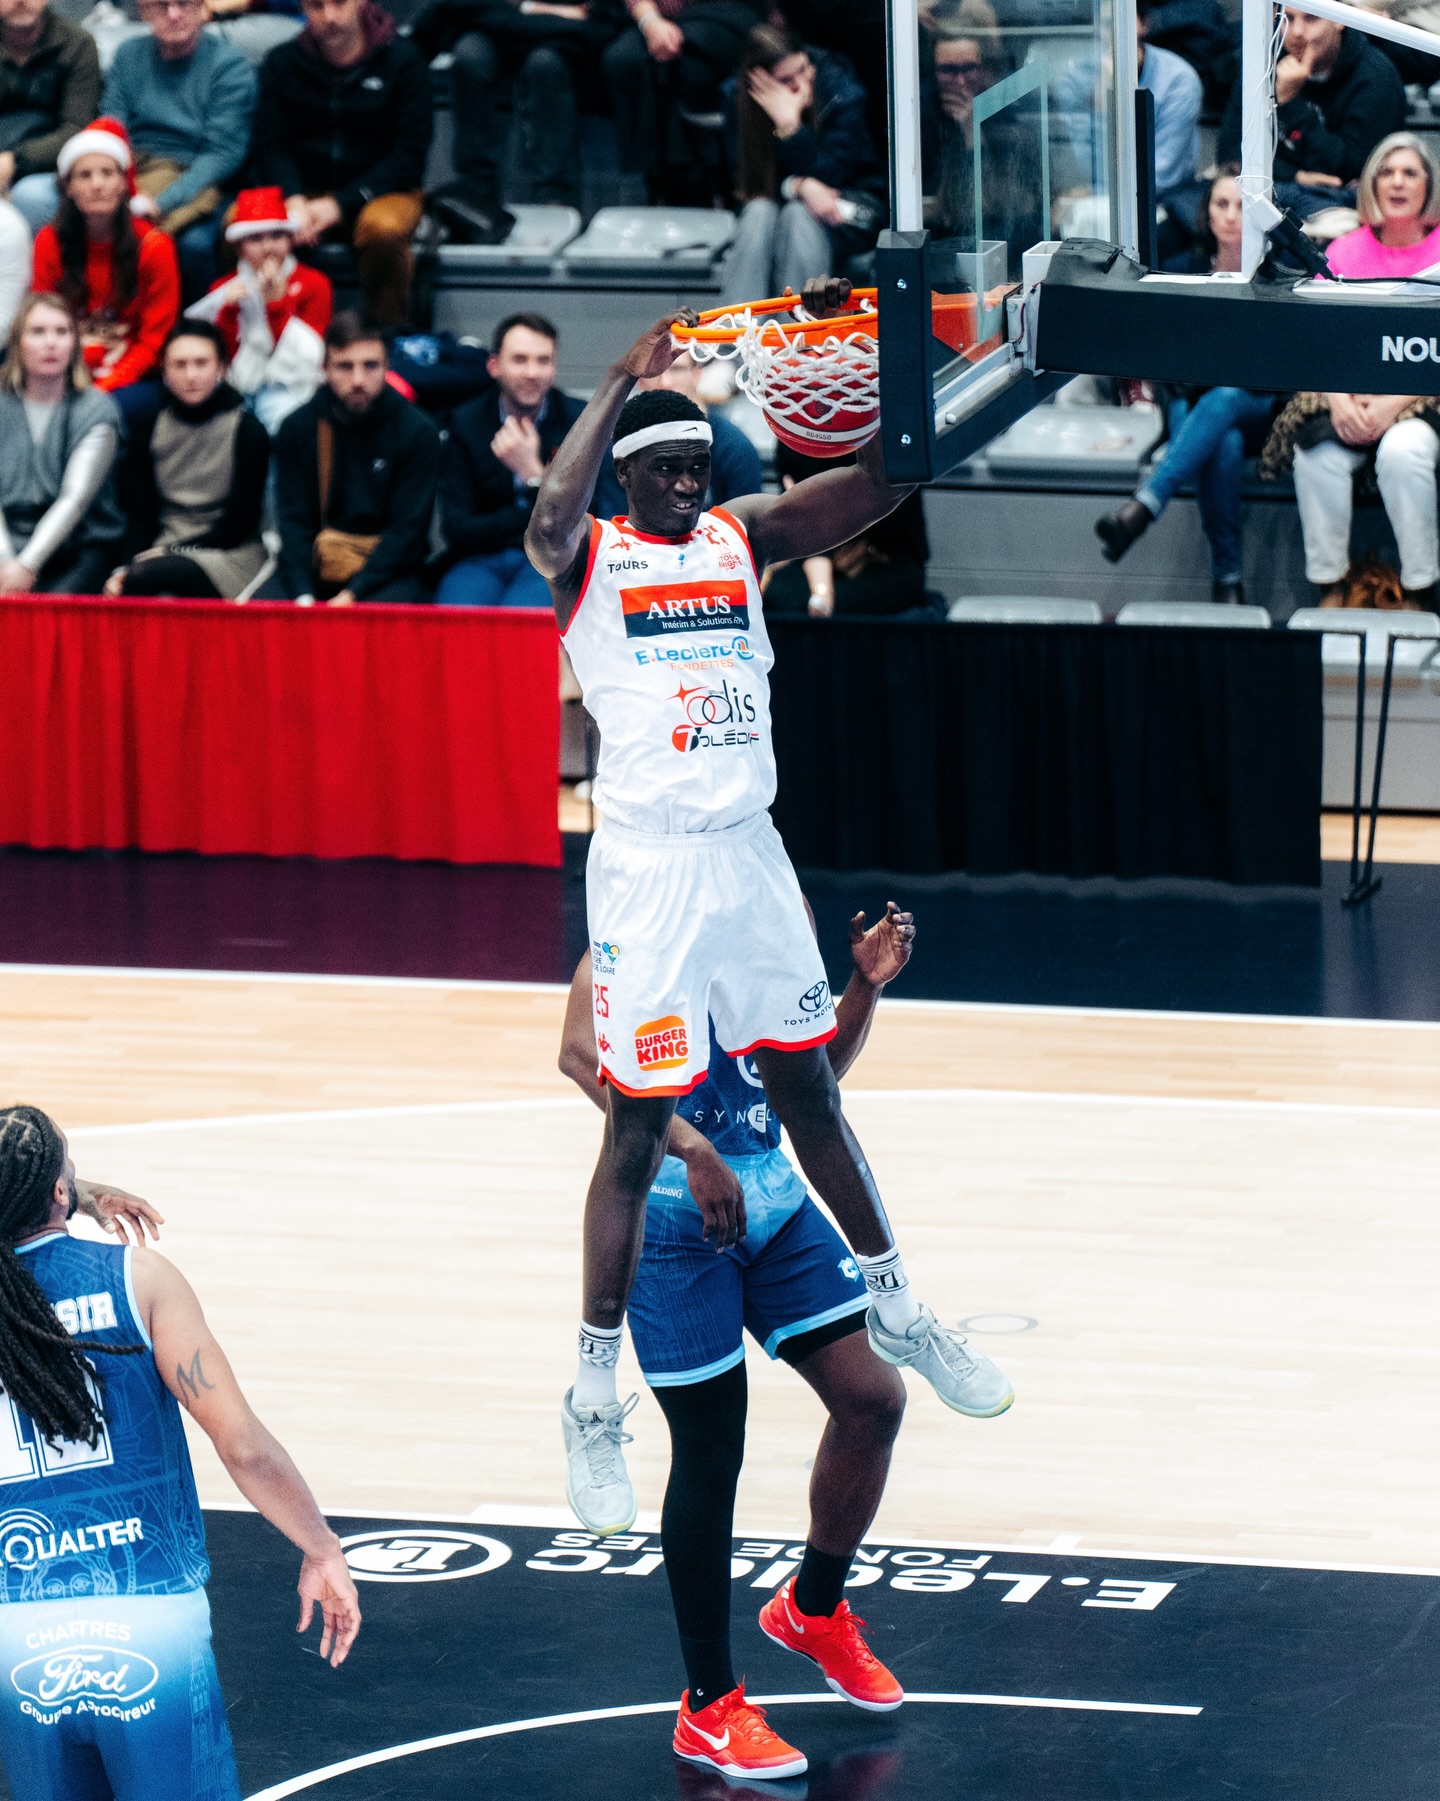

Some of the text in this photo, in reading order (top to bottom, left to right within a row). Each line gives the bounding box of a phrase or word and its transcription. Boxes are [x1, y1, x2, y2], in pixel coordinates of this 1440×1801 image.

[607, 560, 649, 574] TOURS
[647, 595, 731, 620] ARTUS
[662, 620, 689, 629] Intérim
[690, 620, 696, 628] &
[697, 616, 733, 627] Solutions
[635, 645, 732, 666] E.Leclerc
[594, 983, 609, 1018] 25
[783, 1016, 811, 1026] TOYS
[635, 1028, 687, 1049] BURGER
[637, 1040, 689, 1064] KING
[50, 1291, 118, 1336] SIR
[0, 1517, 144, 1570] QUALTER
[38, 1653, 130, 1701] Ford
[20, 1700, 73, 1725] Groupe
